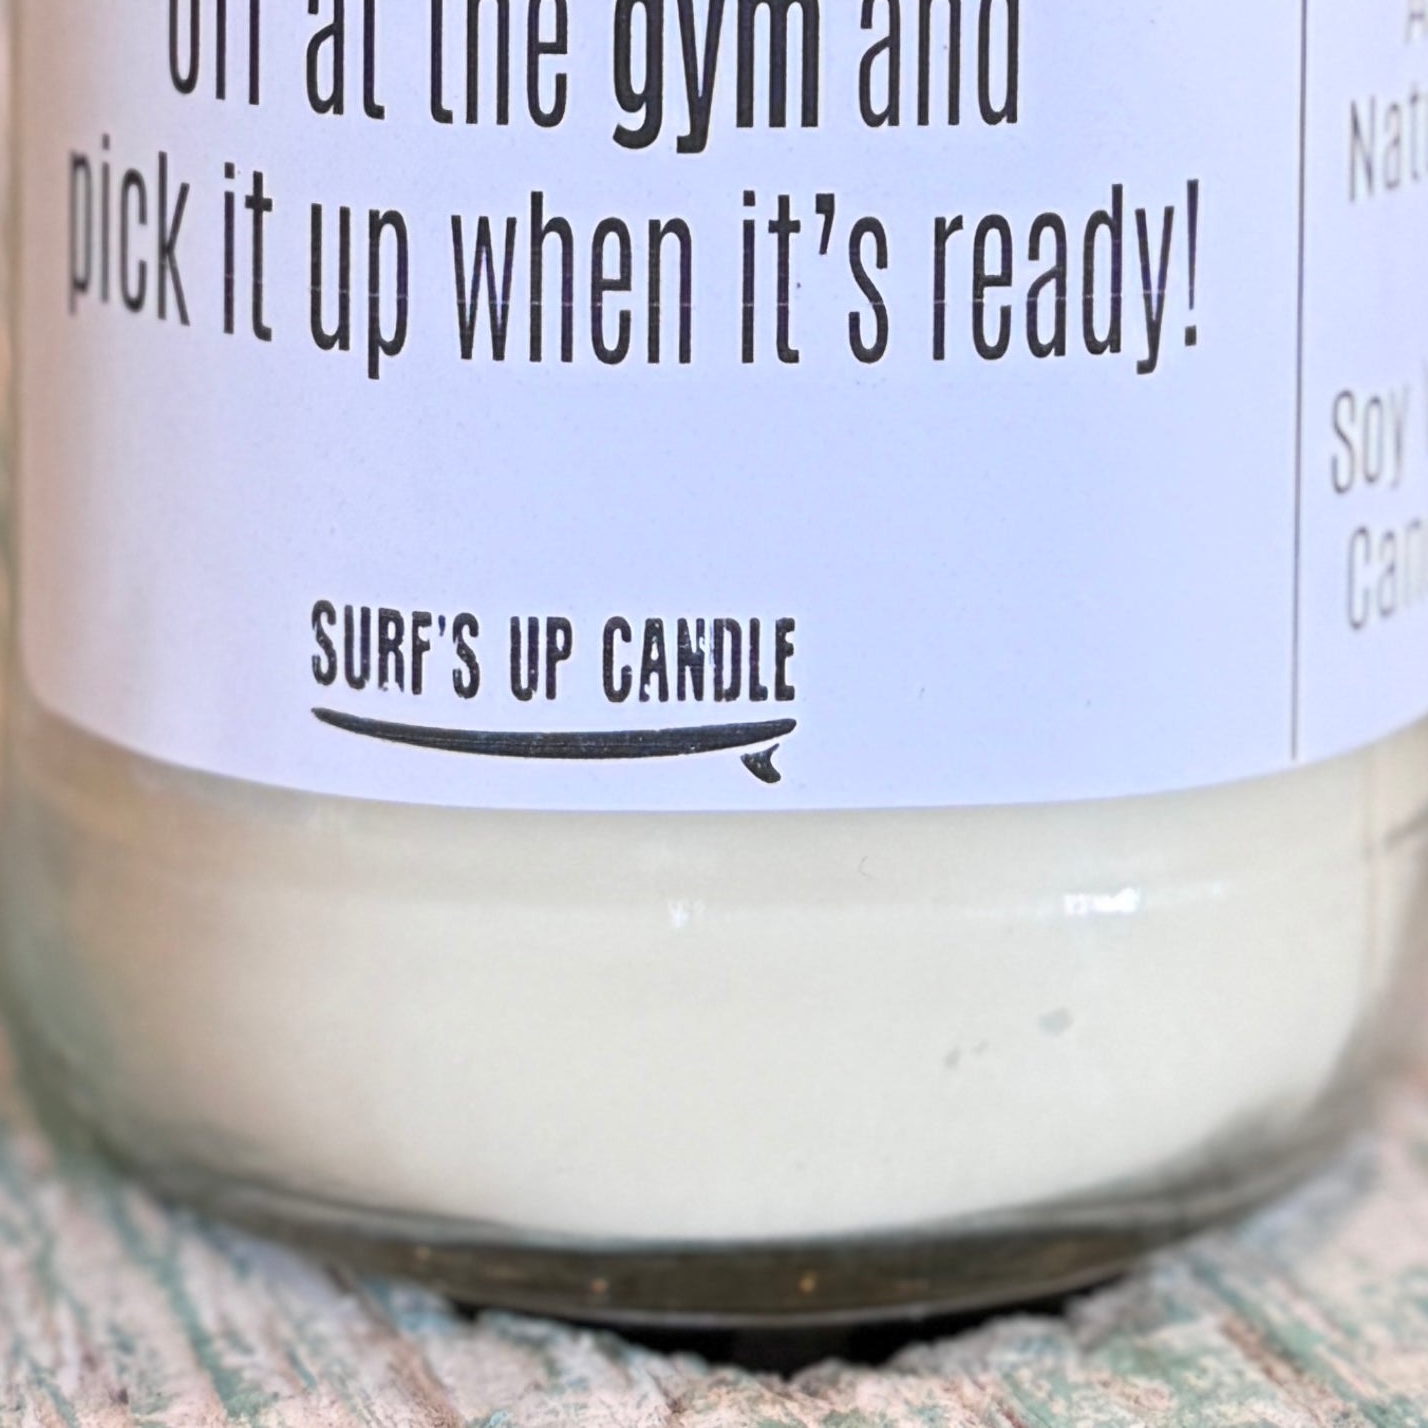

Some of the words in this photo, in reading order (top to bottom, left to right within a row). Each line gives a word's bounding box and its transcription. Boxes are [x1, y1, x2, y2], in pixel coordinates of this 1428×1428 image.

[66, 133, 191, 327] pick
[223, 162, 273, 342] it
[310, 202, 409, 380] up
[450, 190, 692, 366] when
[932, 179, 1199, 375] ready!
[1332, 384, 1409, 494] Soy
[311, 599, 480, 700] SURF'S
[510, 616, 573, 702] UP
[602, 616, 796, 703] CANDLE
